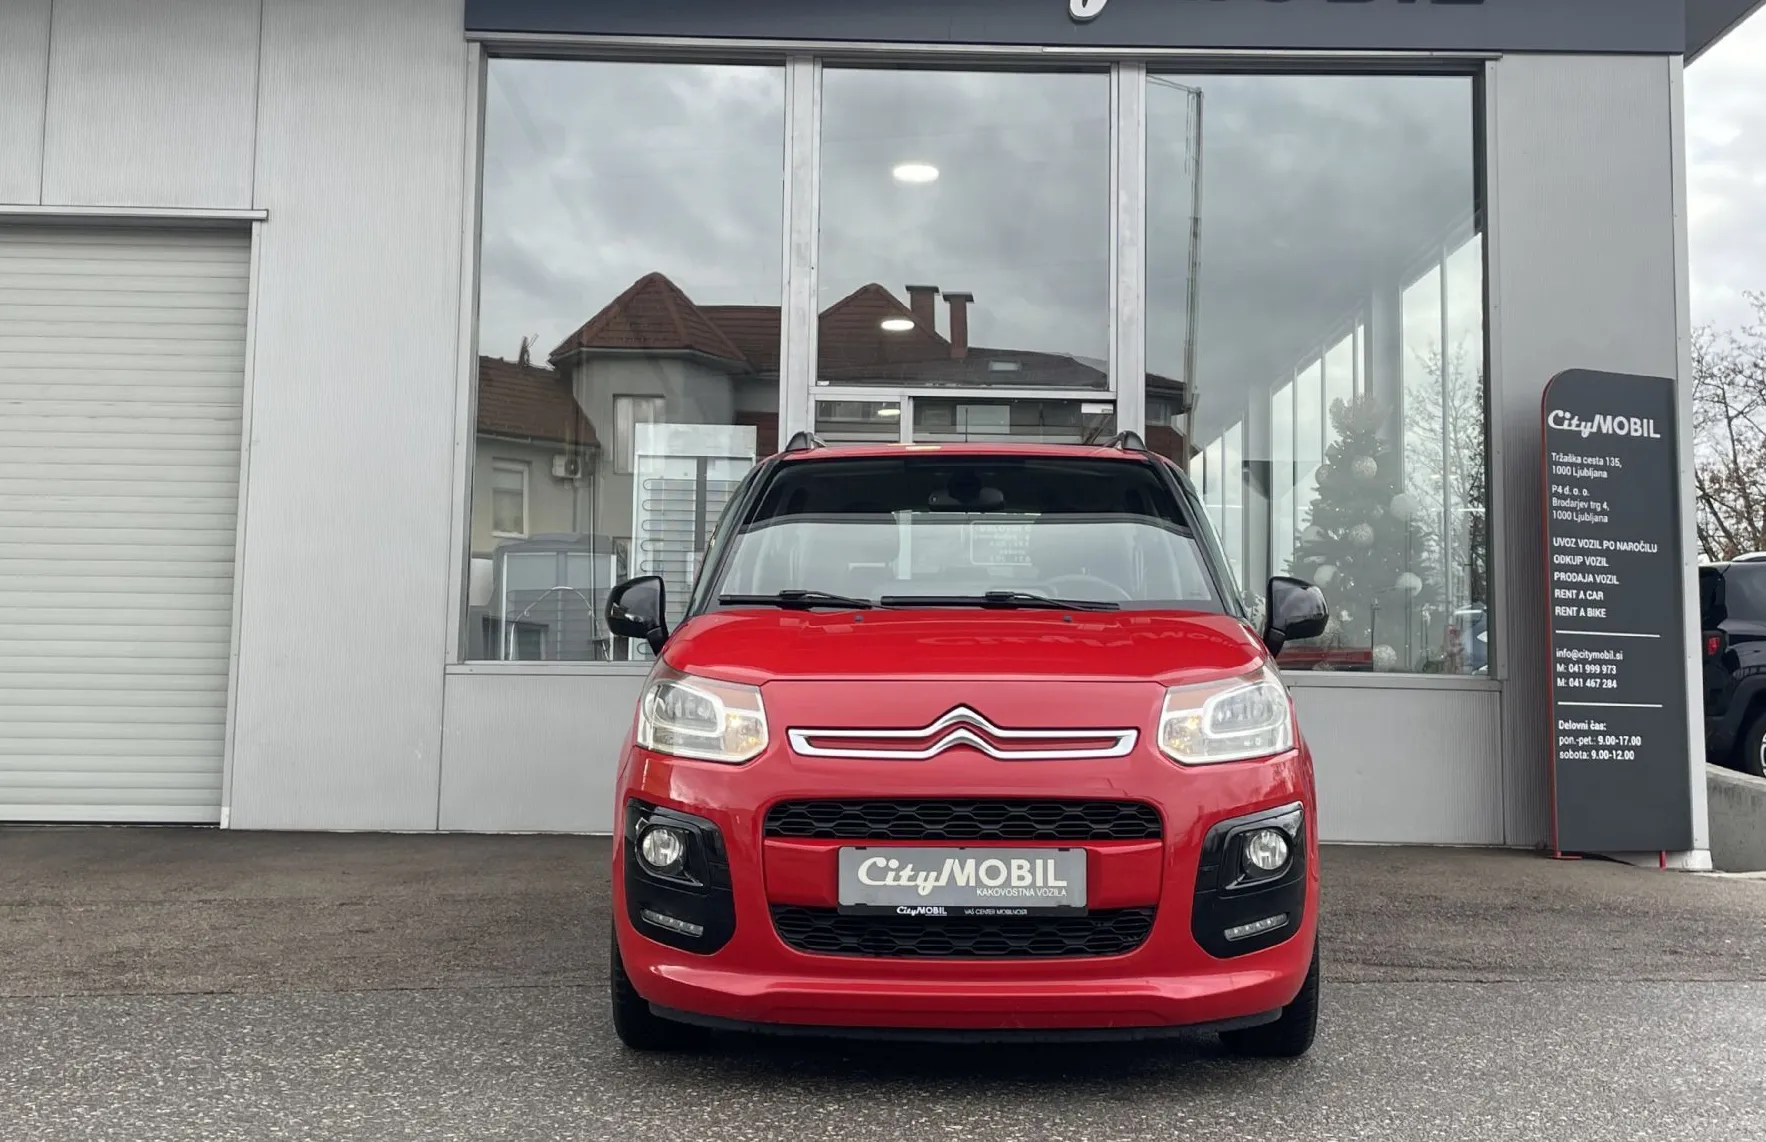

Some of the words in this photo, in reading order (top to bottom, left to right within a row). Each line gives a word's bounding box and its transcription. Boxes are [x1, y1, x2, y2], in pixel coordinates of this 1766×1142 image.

[1548, 409, 1661, 438] CityMOBIL
[1552, 452, 1581, 463] Tržaška
[1582, 456, 1604, 466] cesta
[1606, 456, 1622, 468] 135,
[1552, 465, 1572, 476] 1000
[1572, 466, 1608, 479] Ljubljana
[1552, 484, 1562, 494] P4
[1552, 497, 1588, 510] Brodarjev
[1590, 500, 1600, 512] trg
[1552, 510, 1572, 521] 1000
[1573, 512, 1608, 524] Ljubljana
[1553, 537, 1576, 548] UVOZ
[1577, 538, 1602, 550] VOZIL
[1602, 540, 1614, 550] PO
[1616, 540, 1658, 553] NAROČILU
[1554, 554, 1583, 565] ODKUP
[1584, 556, 1610, 567] VOZIL
[1554, 572, 1594, 582] PRODAJA
[1594, 574, 1620, 584] VOZIL
[1554, 588, 1578, 599] RENT
[1578, 590, 1585, 600] A
[1586, 590, 1604, 600] CAR
[1555, 606, 1578, 616] RENT
[1579, 607, 1586, 616] A
[1586, 608, 1606, 618] BIKE
[1556, 648, 1624, 660] info@citymobil.si
[1556, 663, 1567, 672] M:
[1568, 664, 1582, 673] 041
[1584, 664, 1600, 674] 999
[1602, 664, 1616, 674] 973
[1557, 677, 1568, 686] M:
[1569, 678, 1583, 688] 041
[1586, 678, 1600, 688] 467
[1602, 678, 1617, 688] 284
[1558, 720, 1588, 730] Delovni
[1590, 720, 1606, 730] čas:
[1598, 736, 1642, 746] 9.00-17.00
[1560, 749, 1590, 759] sobota:
[1591, 750, 1634, 760] 9.00-12.00
[858, 856, 1067, 896] CityMOBIL
[976, 888, 1034, 896] KAKOVOSTNA
[1036, 888, 1066, 896] VOZILA
[896, 906, 947, 916] CityMOBIL
